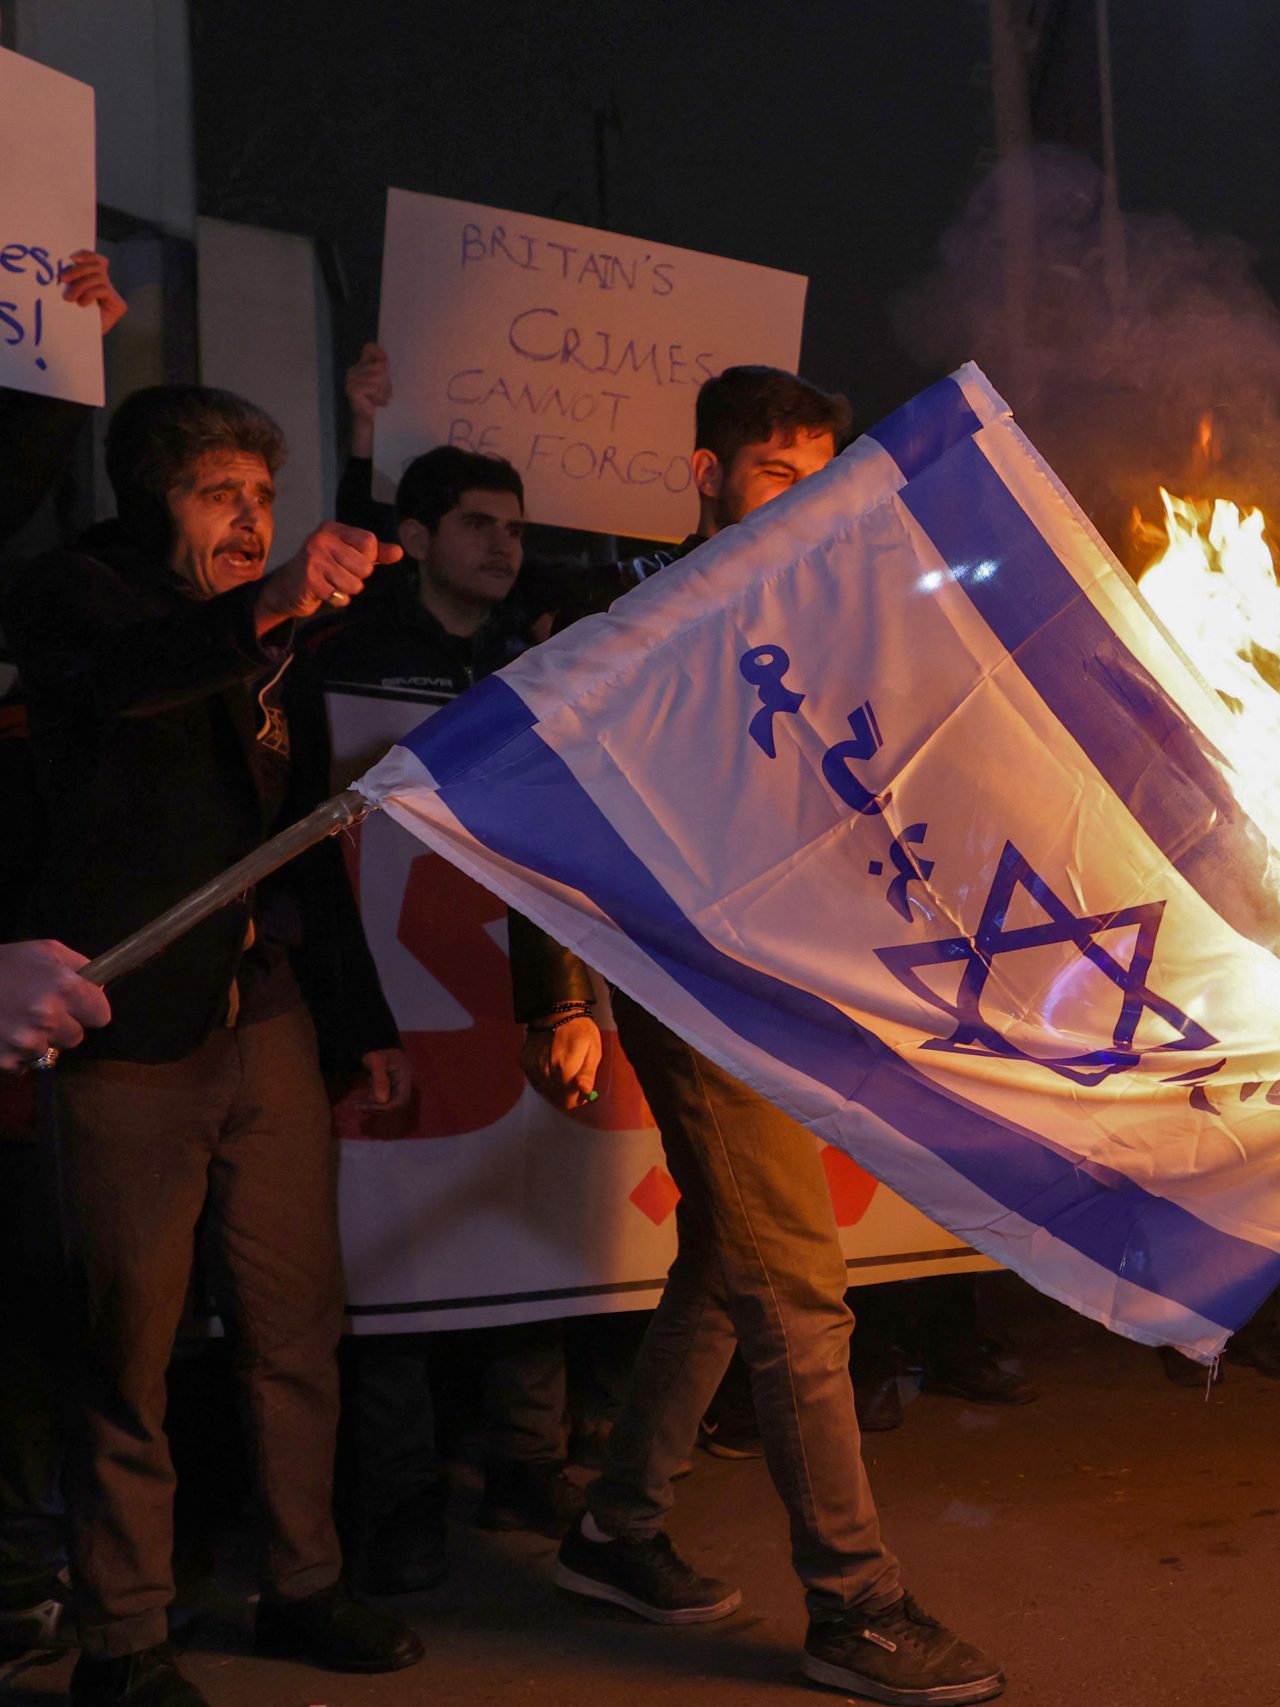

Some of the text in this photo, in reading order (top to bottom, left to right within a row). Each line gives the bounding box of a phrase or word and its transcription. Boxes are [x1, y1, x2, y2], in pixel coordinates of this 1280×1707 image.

[461, 223, 675, 296] BRITAIN'S
[509, 308, 713, 386] CRIMES
[447, 369, 630, 431] CANNOT
[448, 418, 692, 493] BE FORGO
